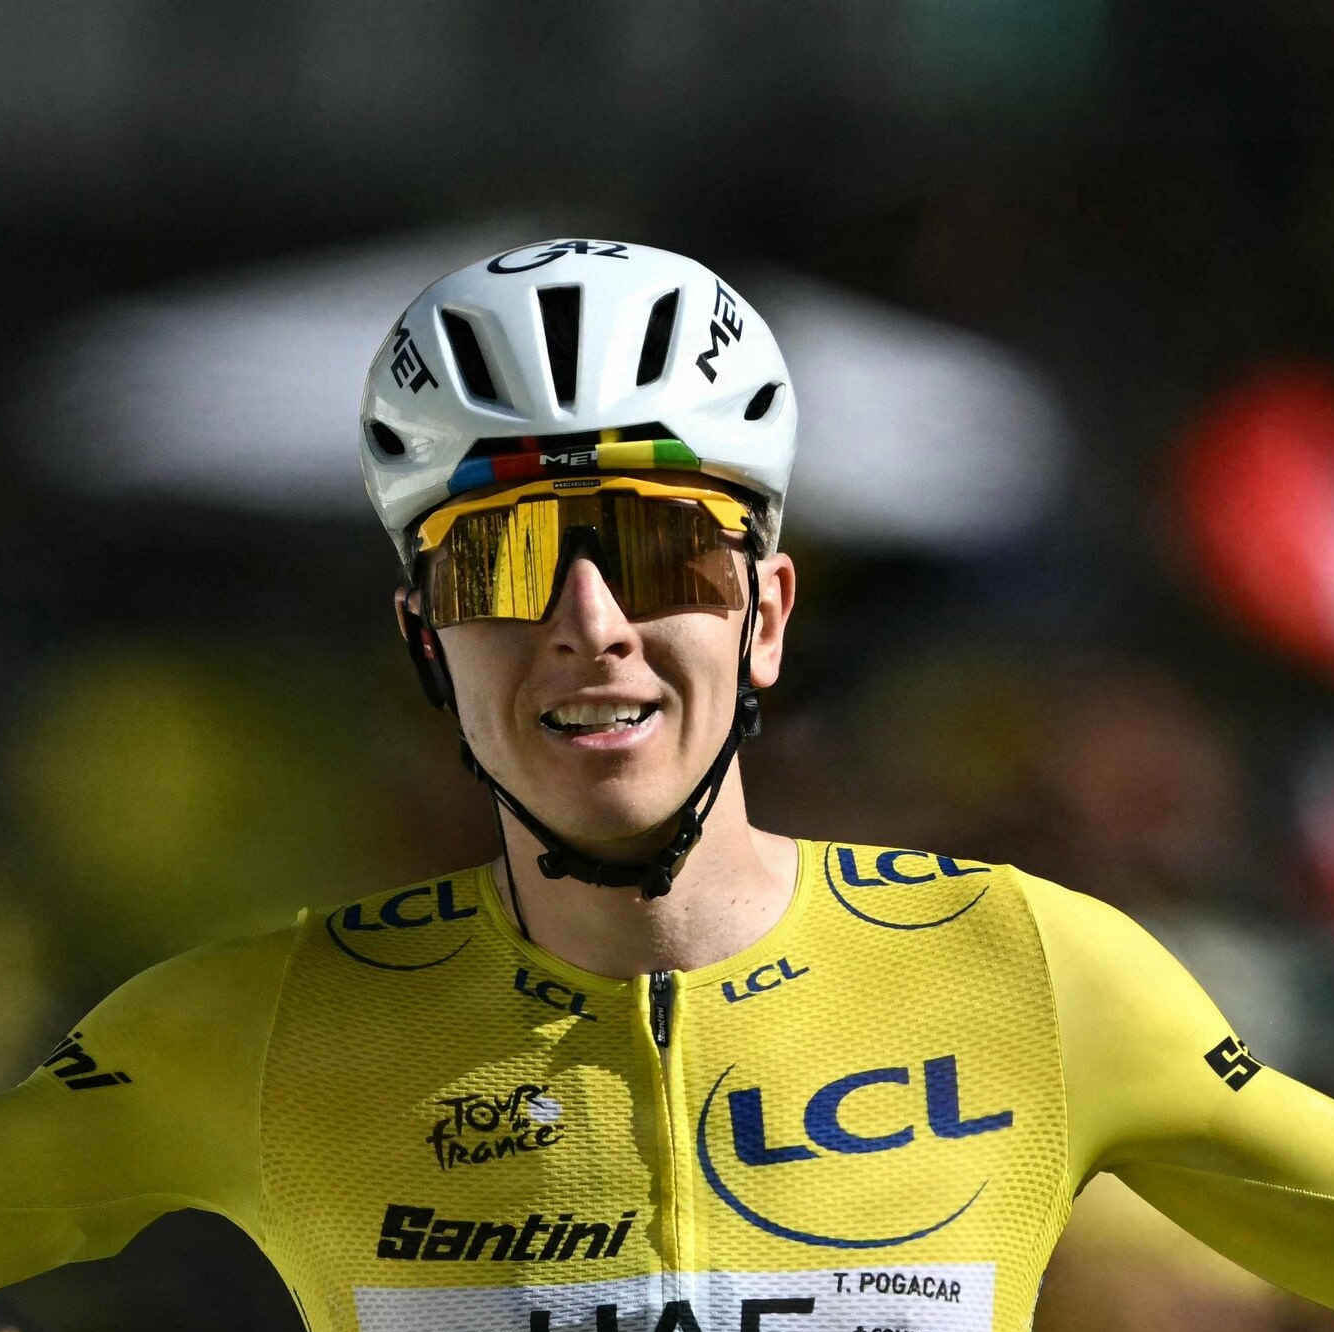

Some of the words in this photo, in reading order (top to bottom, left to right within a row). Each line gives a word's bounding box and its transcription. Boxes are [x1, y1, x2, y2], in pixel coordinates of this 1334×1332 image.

[695, 279, 745, 384] MET
[835, 845, 992, 889] LCL
[340, 880, 479, 932] LCL
[513, 966, 598, 1022] LCL
[721, 956, 811, 1004] LCL
[726, 1053, 1014, 1168] LCL
[377, 1203, 637, 1262] Santini
[833, 1272, 852, 1294] T.
[859, 1272, 962, 1304] POGACAR
